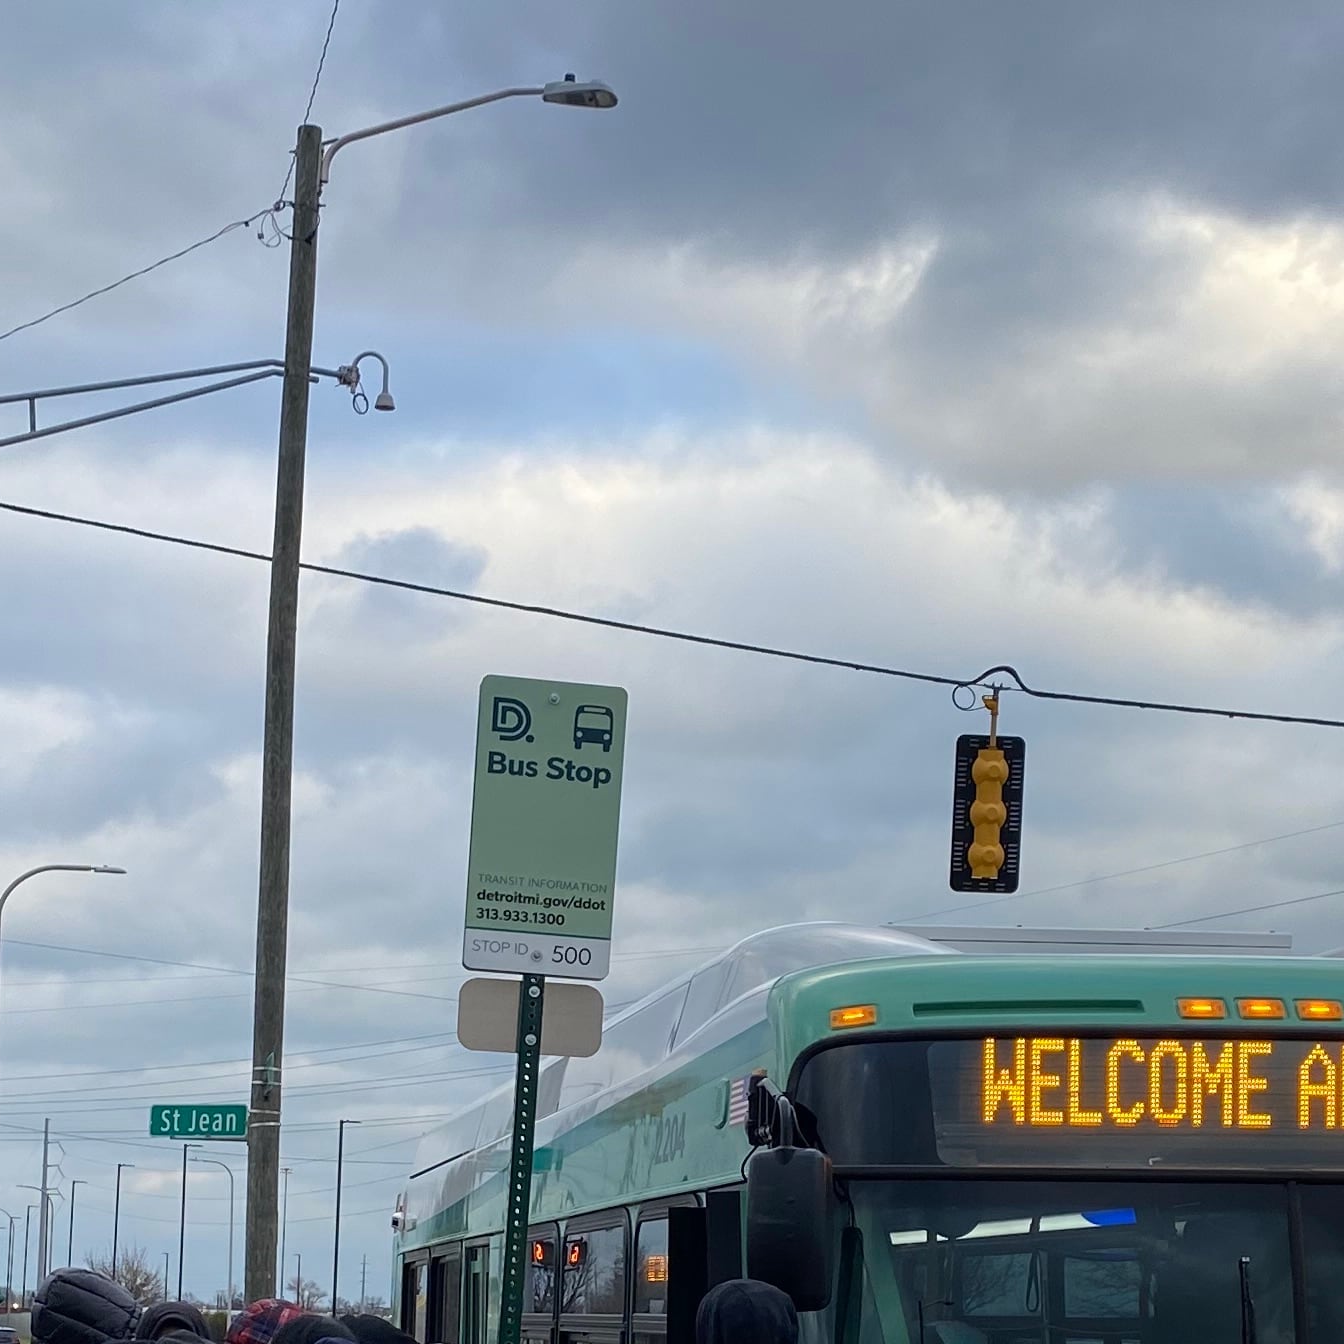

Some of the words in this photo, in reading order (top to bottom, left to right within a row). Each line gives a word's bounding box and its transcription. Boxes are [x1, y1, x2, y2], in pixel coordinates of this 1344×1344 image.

[488, 751, 538, 777] Bus
[546, 757, 612, 789] Stop
[478, 873, 525, 887] TRANSIT
[528, 878, 608, 893] INFORMATION
[476, 889, 606, 911] detroitmi.gov/ddot
[476, 907, 565, 926] 313.933.1300
[471, 939, 511, 954] STOP
[514, 943, 529, 956] ID
[552, 945, 592, 966] 500
[982, 1037, 1273, 1128] WELCOME
[160, 1109, 181, 1132] St
[188, 1109, 237, 1132] Jean
